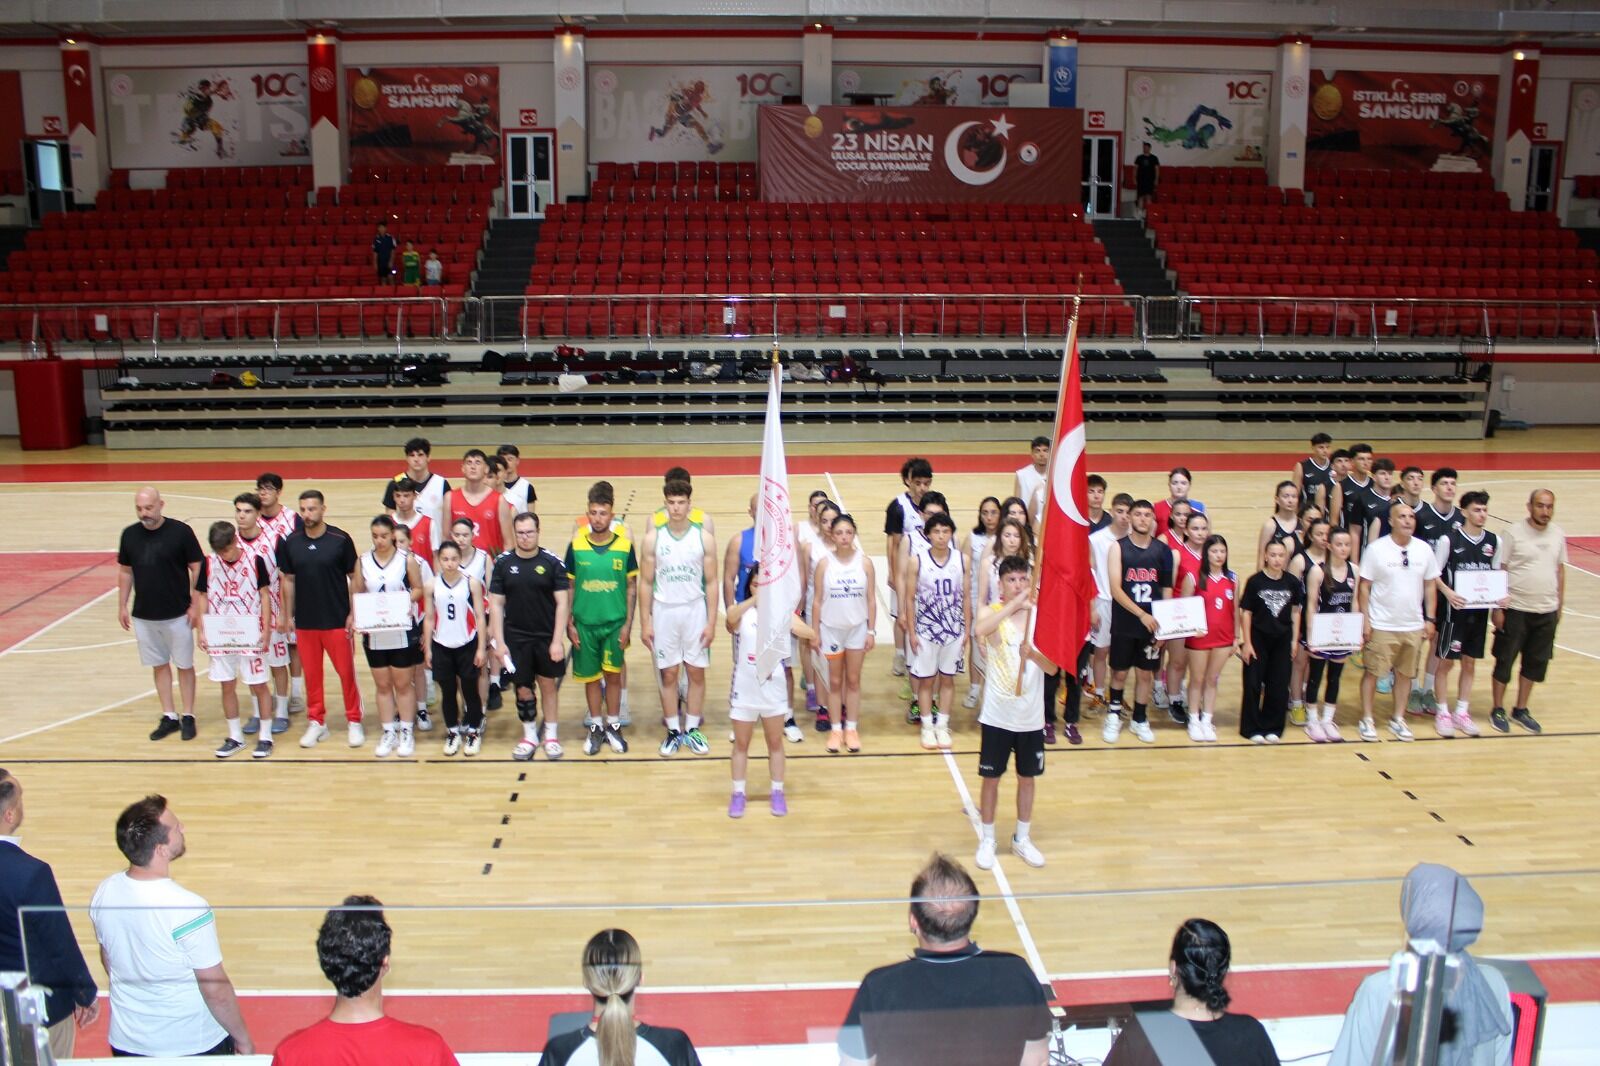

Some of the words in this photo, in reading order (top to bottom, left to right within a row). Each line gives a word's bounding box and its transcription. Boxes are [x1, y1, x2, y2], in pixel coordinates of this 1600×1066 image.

[388, 94, 459, 108] SAMSUN
[1353, 90, 1408, 103] İSTİKLAL
[521, 112, 537, 125] C3
[1359, 103, 1440, 120] SAMSUN
[1089, 114, 1105, 126] C2
[832, 133, 858, 151] 23
[864, 131, 934, 151] NİSAN
[831, 151, 866, 161] ULUSAL
[919, 152, 933, 161] VE
[835, 161, 869, 172] ÇOCUK
[1125, 567, 1158, 582] ADA
[224, 581, 239, 597] 12
[934, 578, 952, 596] 10
[1131, 583, 1153, 603] 12
[1215, 597, 1224, 610] 9
[447, 603, 455, 620] 9
[274, 641, 287, 658] 15
[1144, 645, 1160, 660] 12
[250, 658, 264, 674] 12
